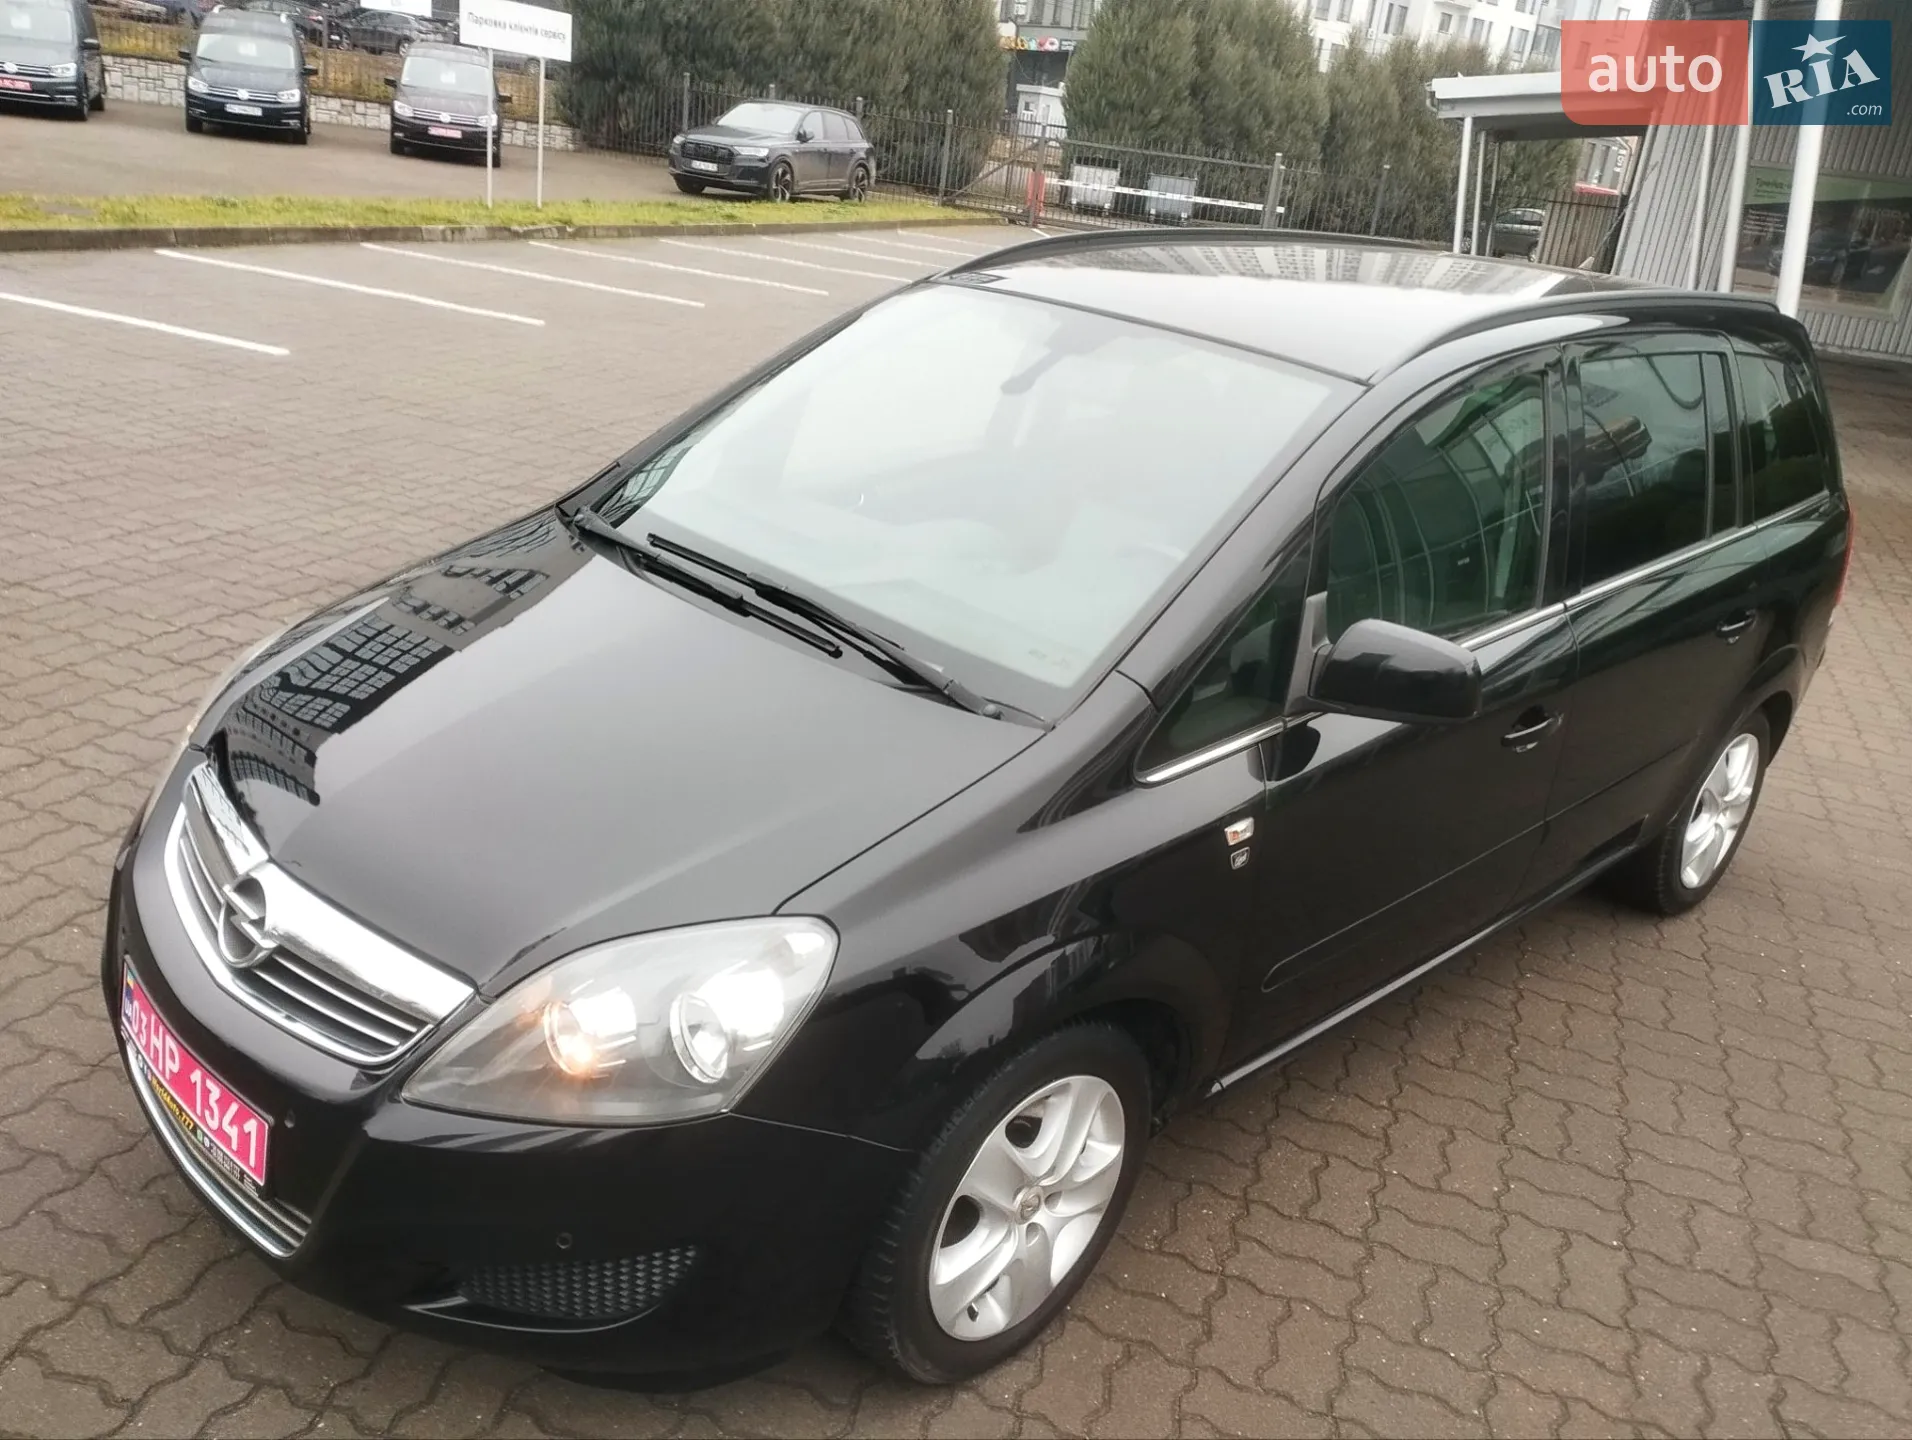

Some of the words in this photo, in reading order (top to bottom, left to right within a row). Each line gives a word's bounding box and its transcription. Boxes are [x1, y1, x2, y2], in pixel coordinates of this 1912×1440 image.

[468, 11, 507, 30] Парковка
[509, 20, 539, 36] клієнтів
[190, 1068, 258, 1169] 1341
